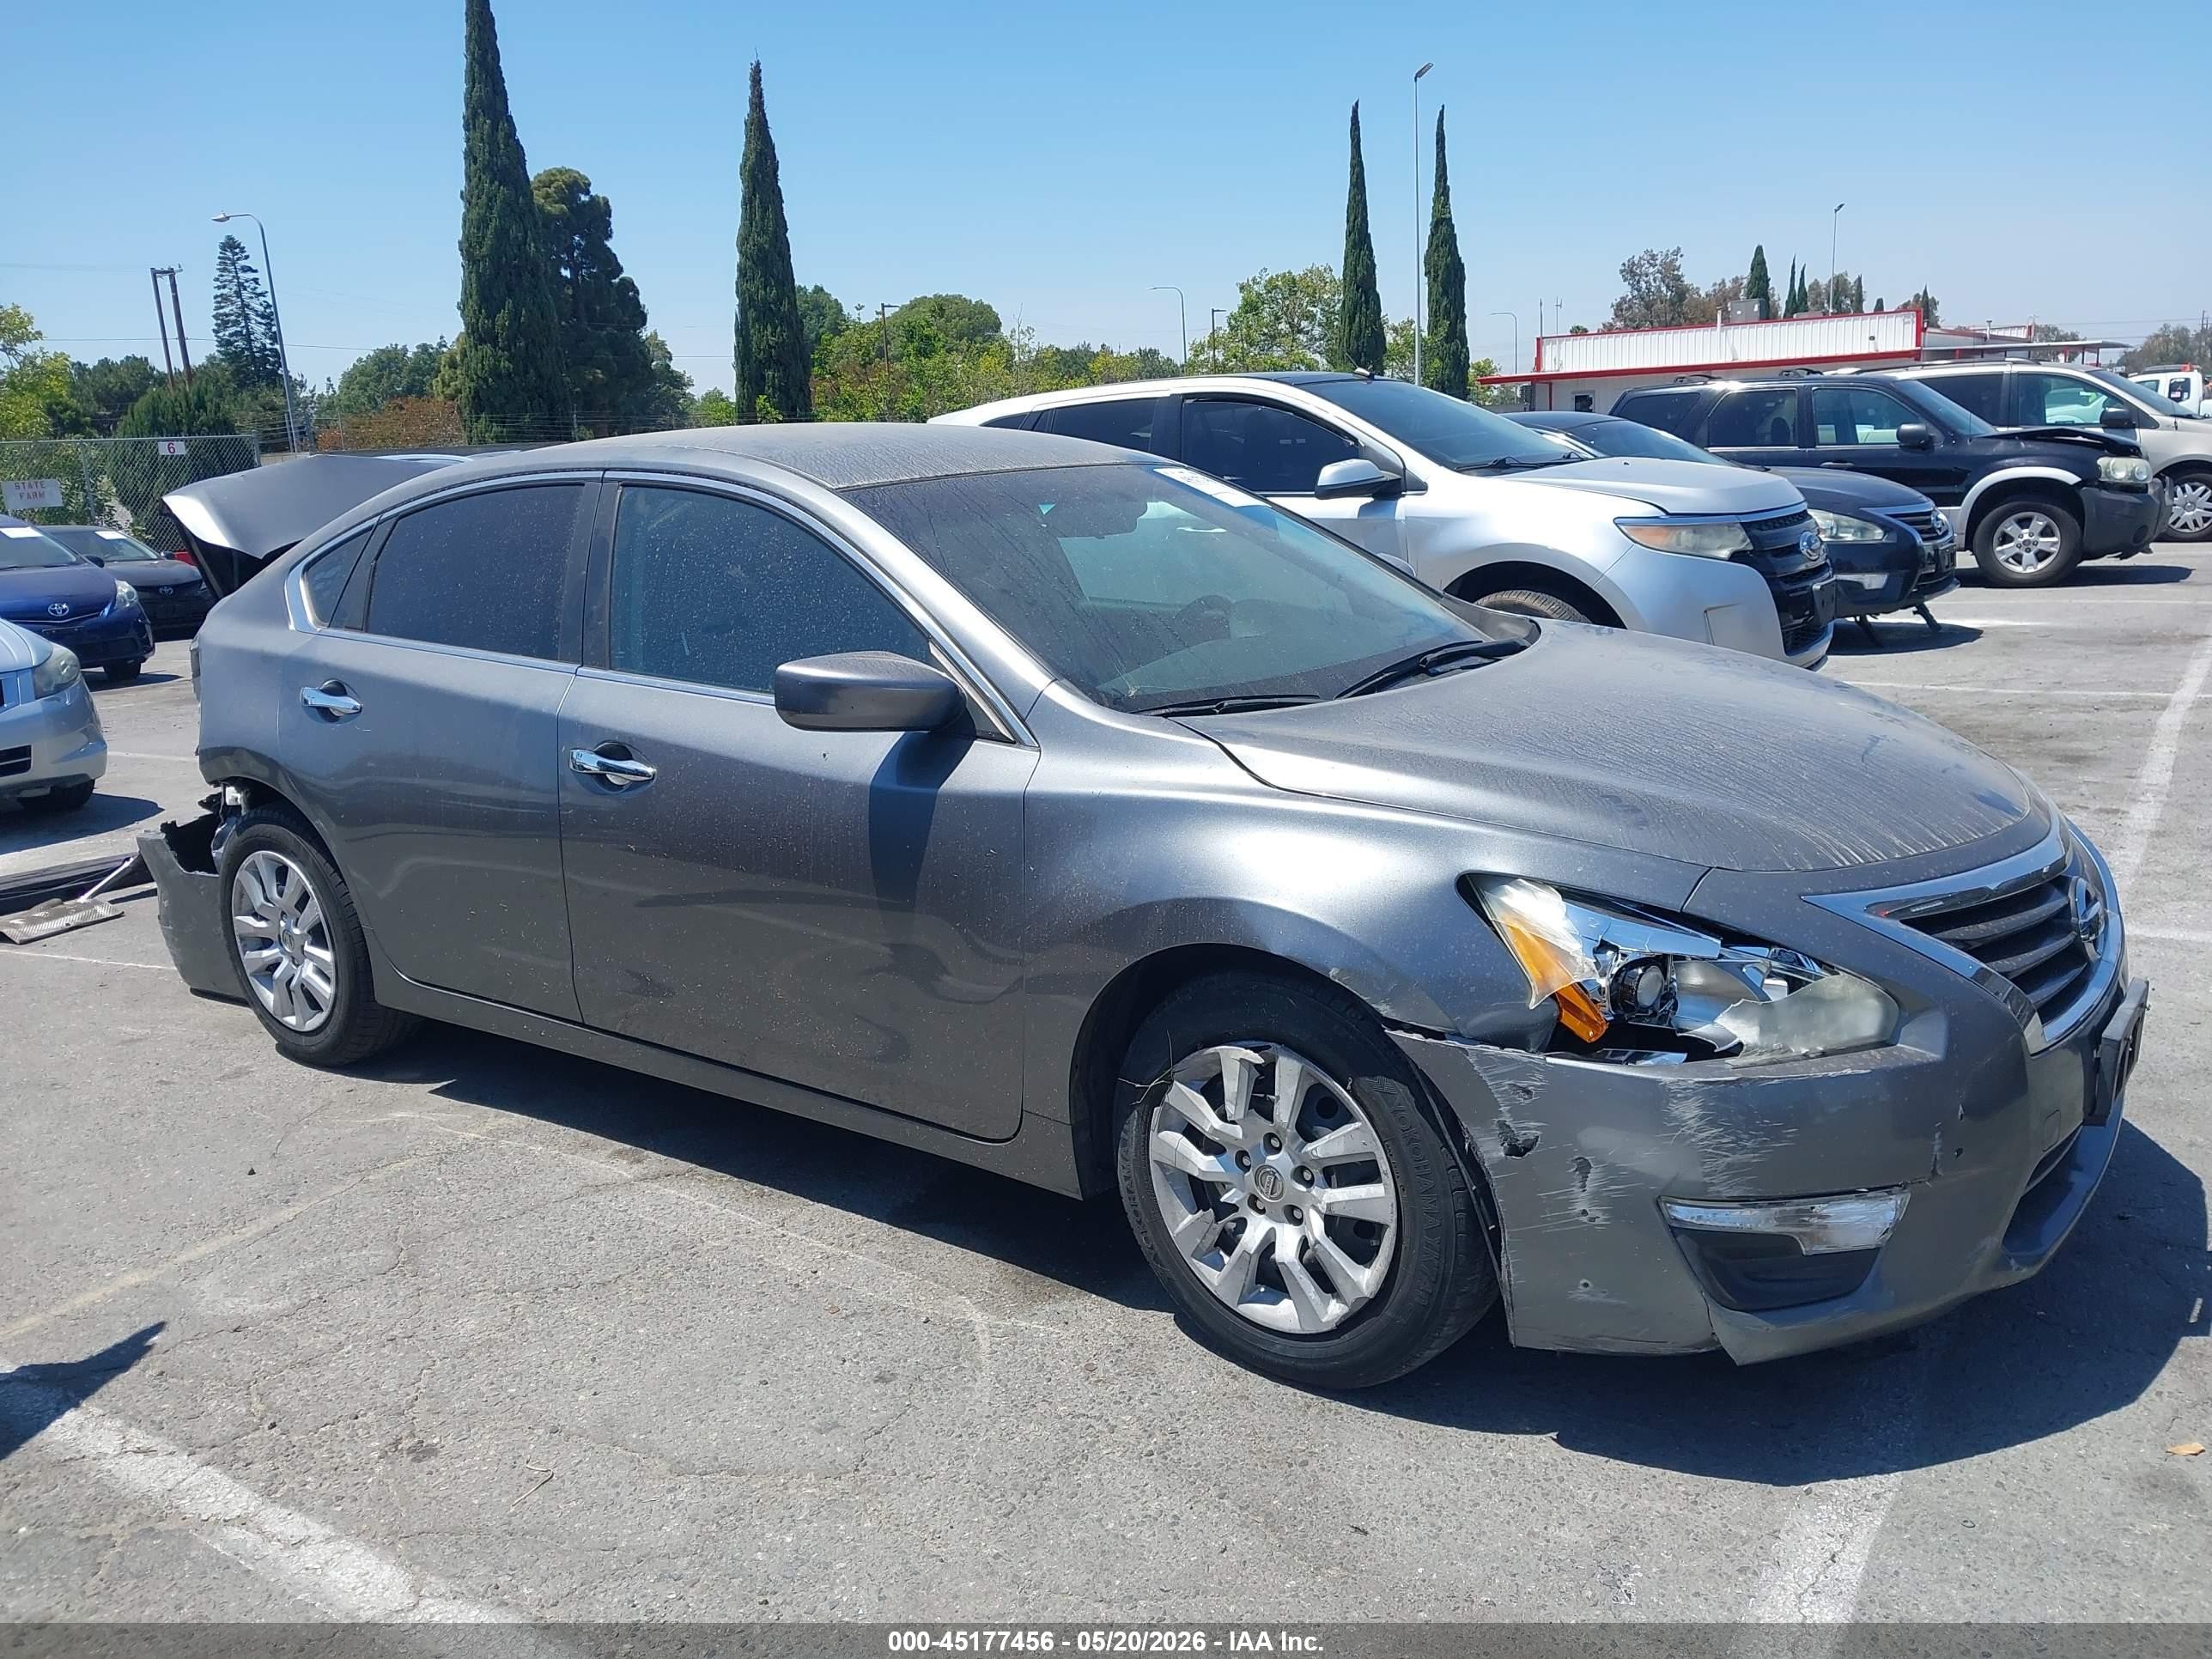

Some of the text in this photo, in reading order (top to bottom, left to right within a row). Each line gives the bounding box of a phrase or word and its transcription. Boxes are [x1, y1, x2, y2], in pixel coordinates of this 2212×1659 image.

[167, 442, 175, 453] 6
[15, 481, 46, 490] STATE
[20, 491, 45, 500] FARM
[1390, 1094, 1443, 1231] YOKOHAMA
